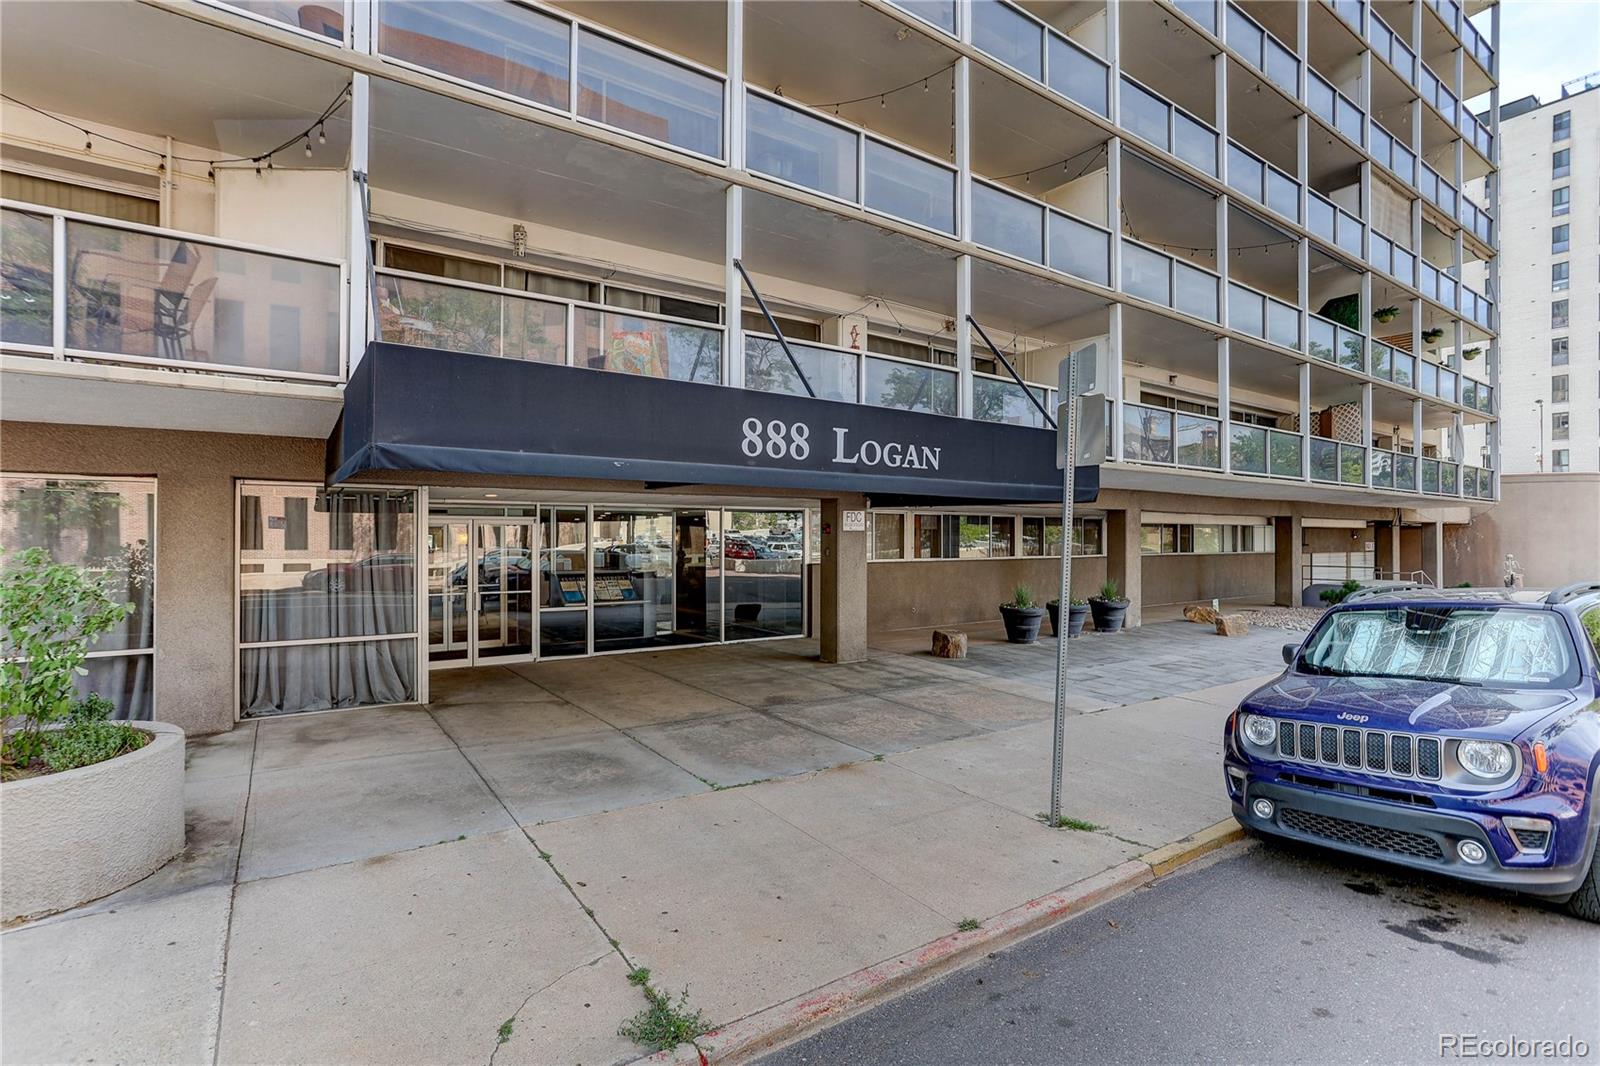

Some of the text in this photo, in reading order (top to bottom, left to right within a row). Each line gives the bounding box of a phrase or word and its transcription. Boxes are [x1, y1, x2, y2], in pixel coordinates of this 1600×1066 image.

[741, 417, 941, 471] 888 LOGAN
[846, 511, 862, 523] FDC
[1336, 711, 1369, 724] Jeep
